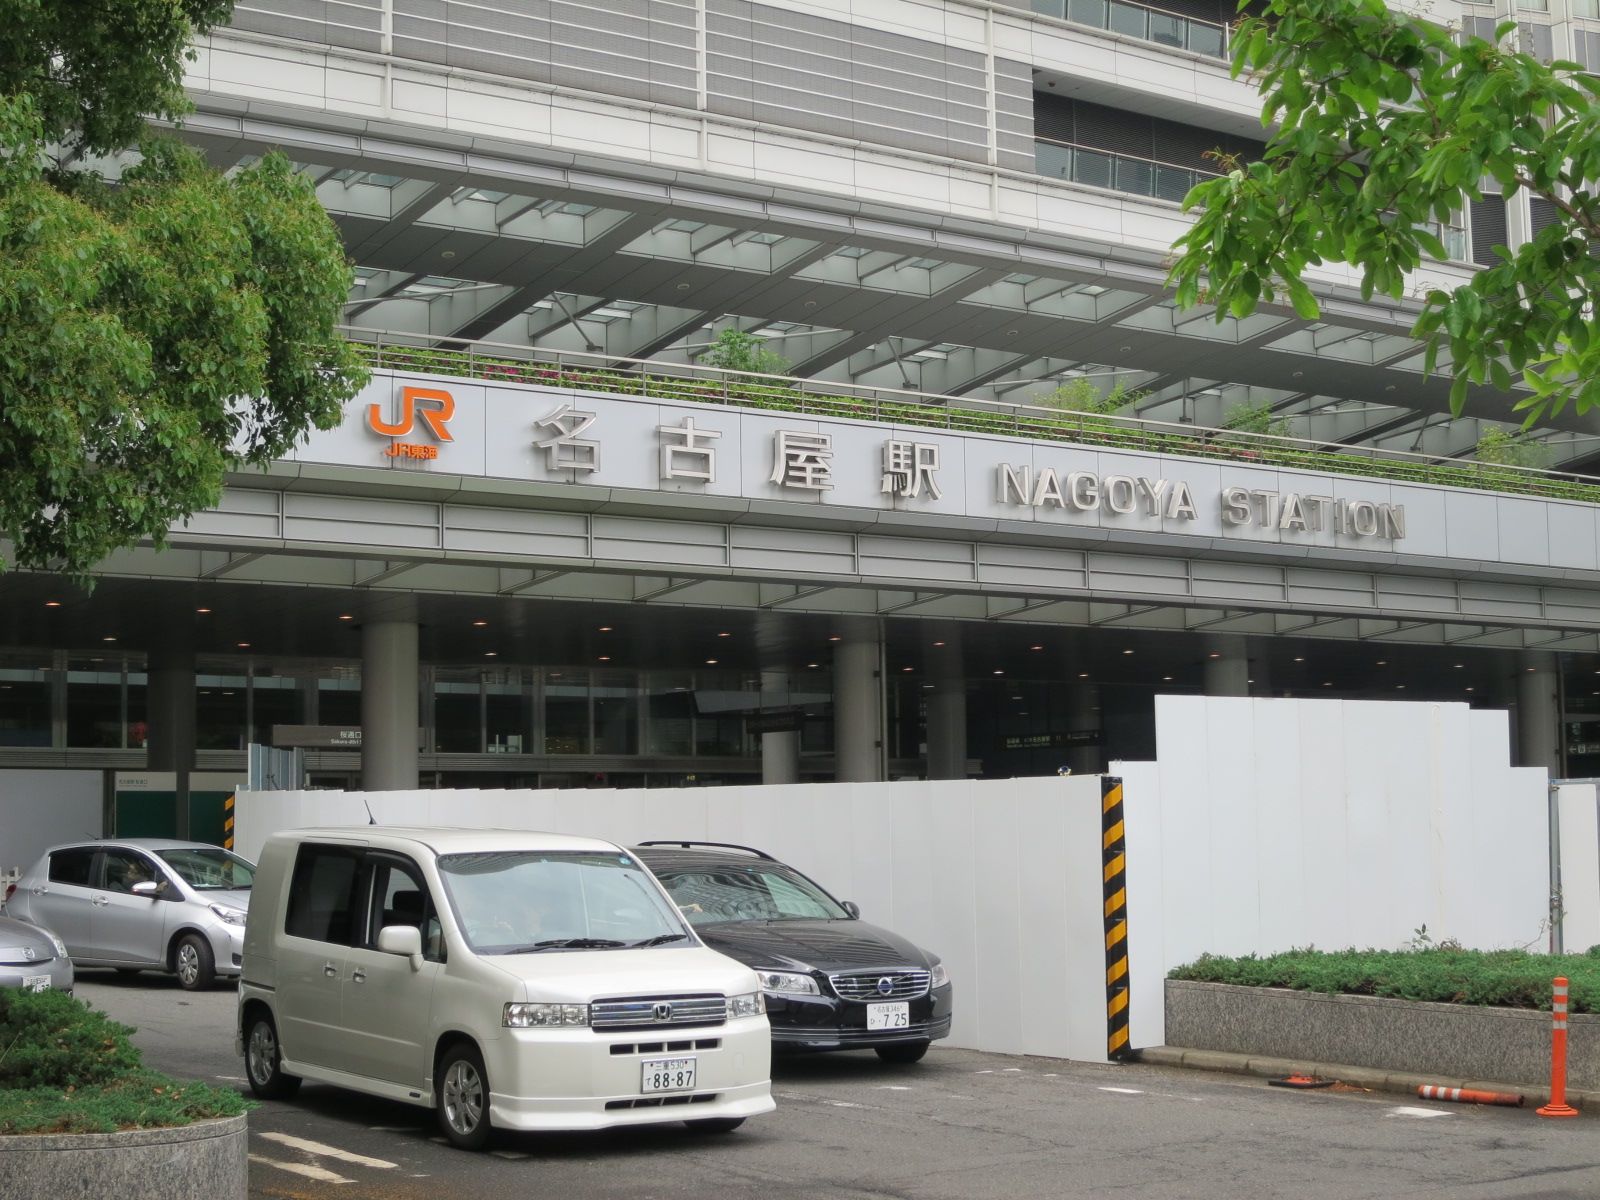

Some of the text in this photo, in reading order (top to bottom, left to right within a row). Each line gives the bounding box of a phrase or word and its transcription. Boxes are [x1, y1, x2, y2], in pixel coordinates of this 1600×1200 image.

[365, 385, 456, 442] JR
[532, 403, 943, 502] 名古屋駅
[996, 462, 1406, 540] NAGOYA STATION
[653, 1070, 693, 1089] 88-87
